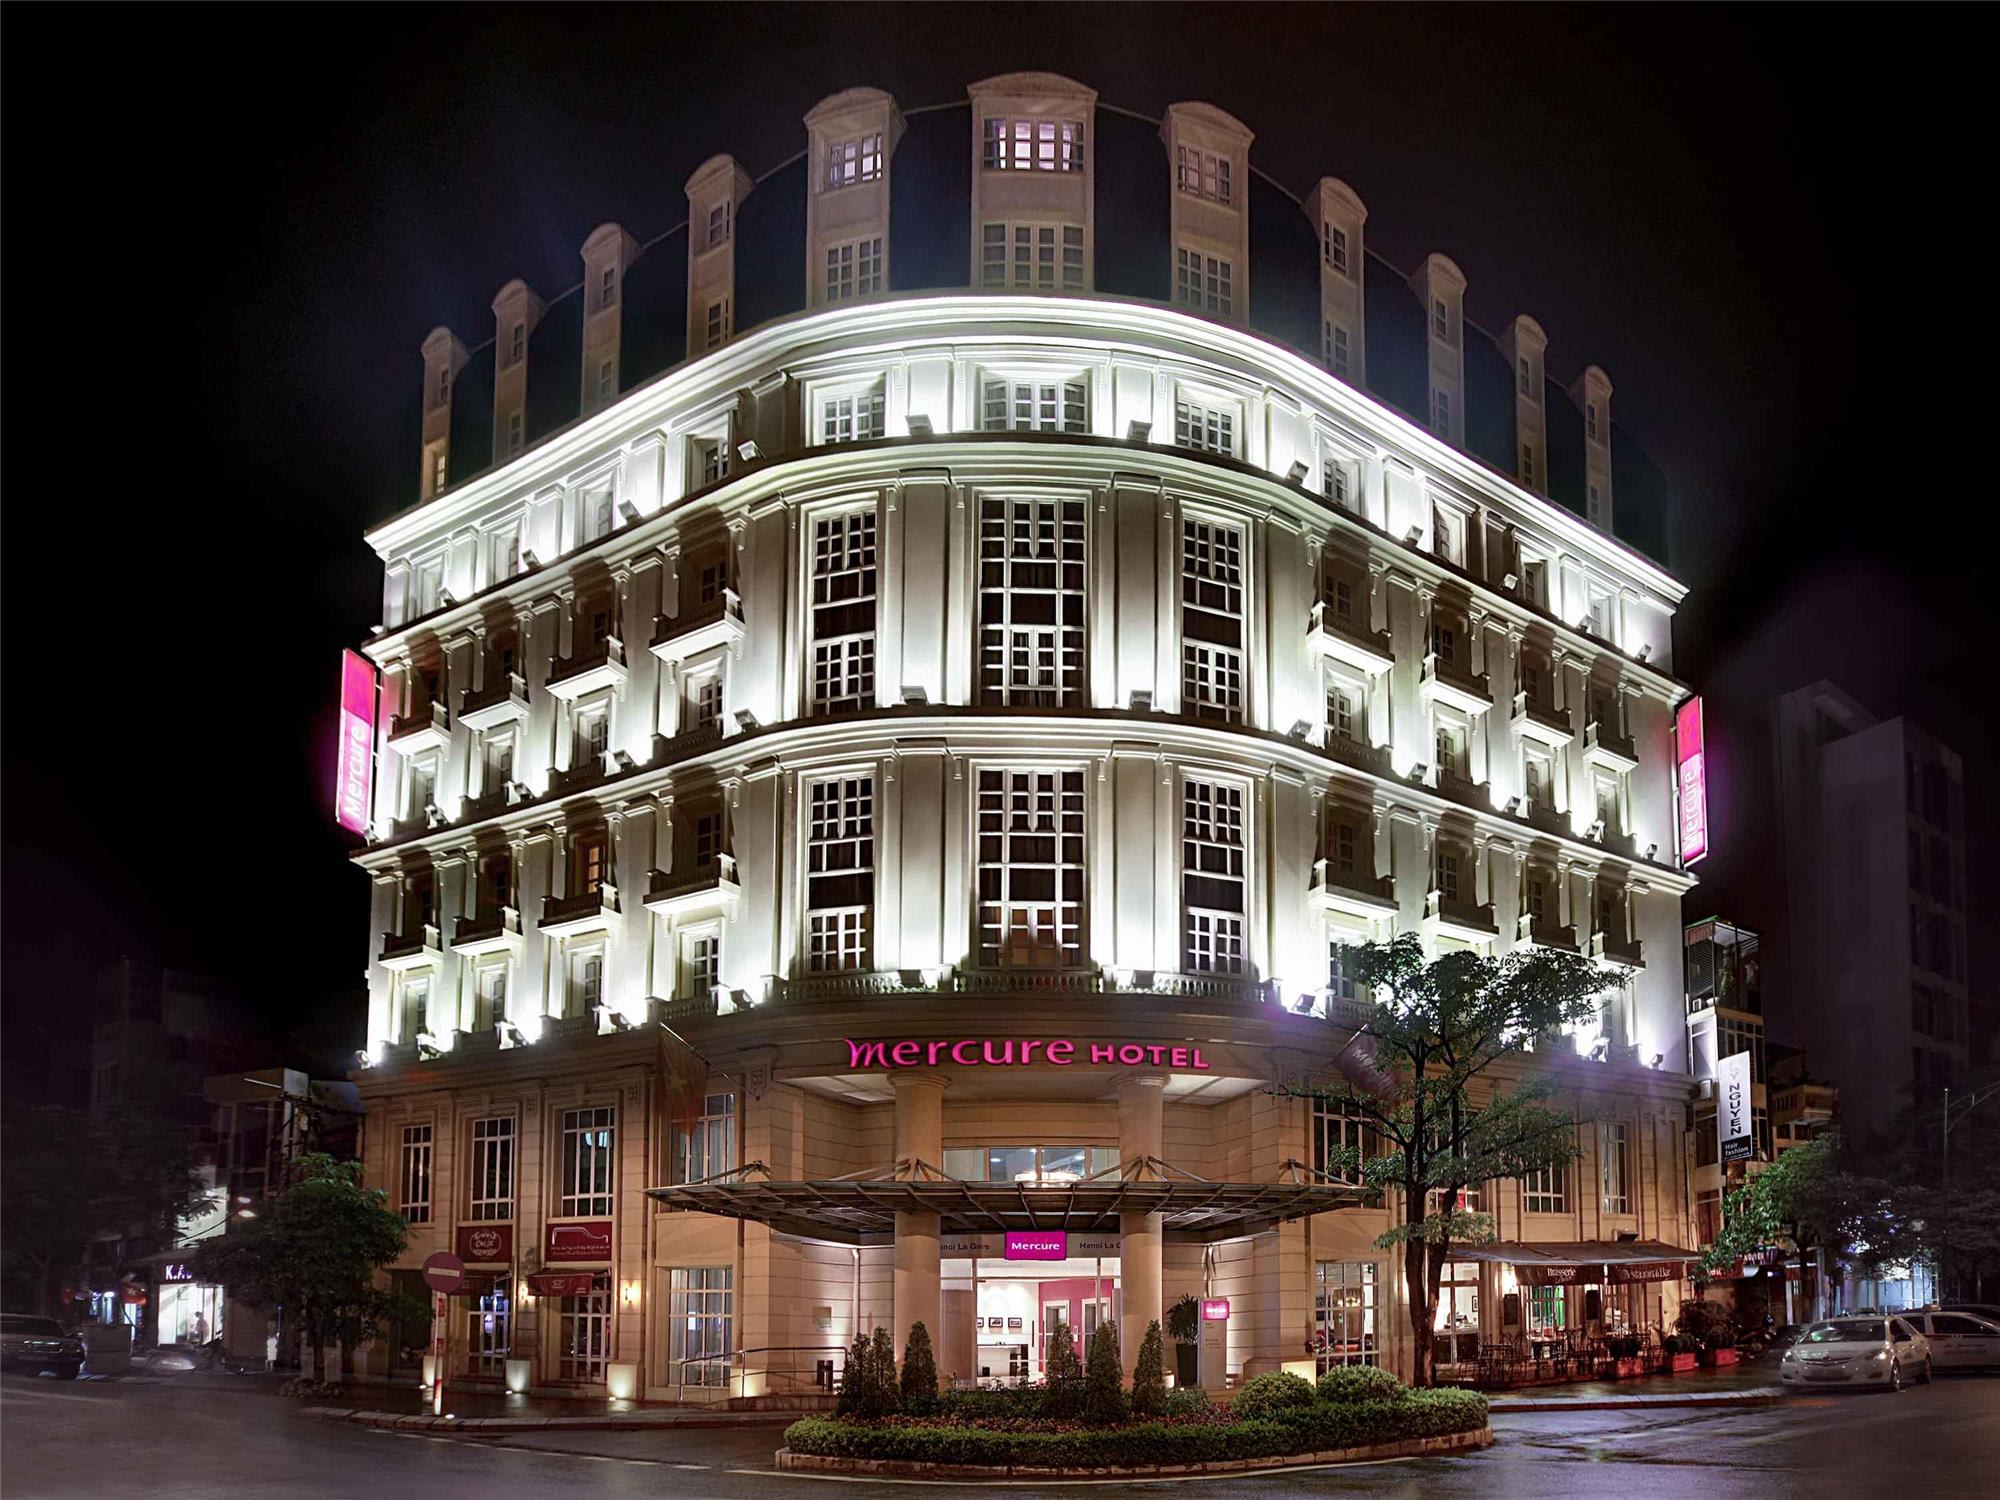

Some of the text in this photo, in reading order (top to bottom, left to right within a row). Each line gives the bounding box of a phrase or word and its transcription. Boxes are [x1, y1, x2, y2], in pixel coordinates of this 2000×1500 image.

[1090, 1043, 1210, 1069] HOTEL
[1729, 1083, 1742, 1136] NGUYEN
[1725, 1141, 1738, 1151] Hair
[1725, 1146, 1749, 1157] fashion
[957, 1242, 968, 1250] La
[1011, 1242, 1060, 1250] Mercure
